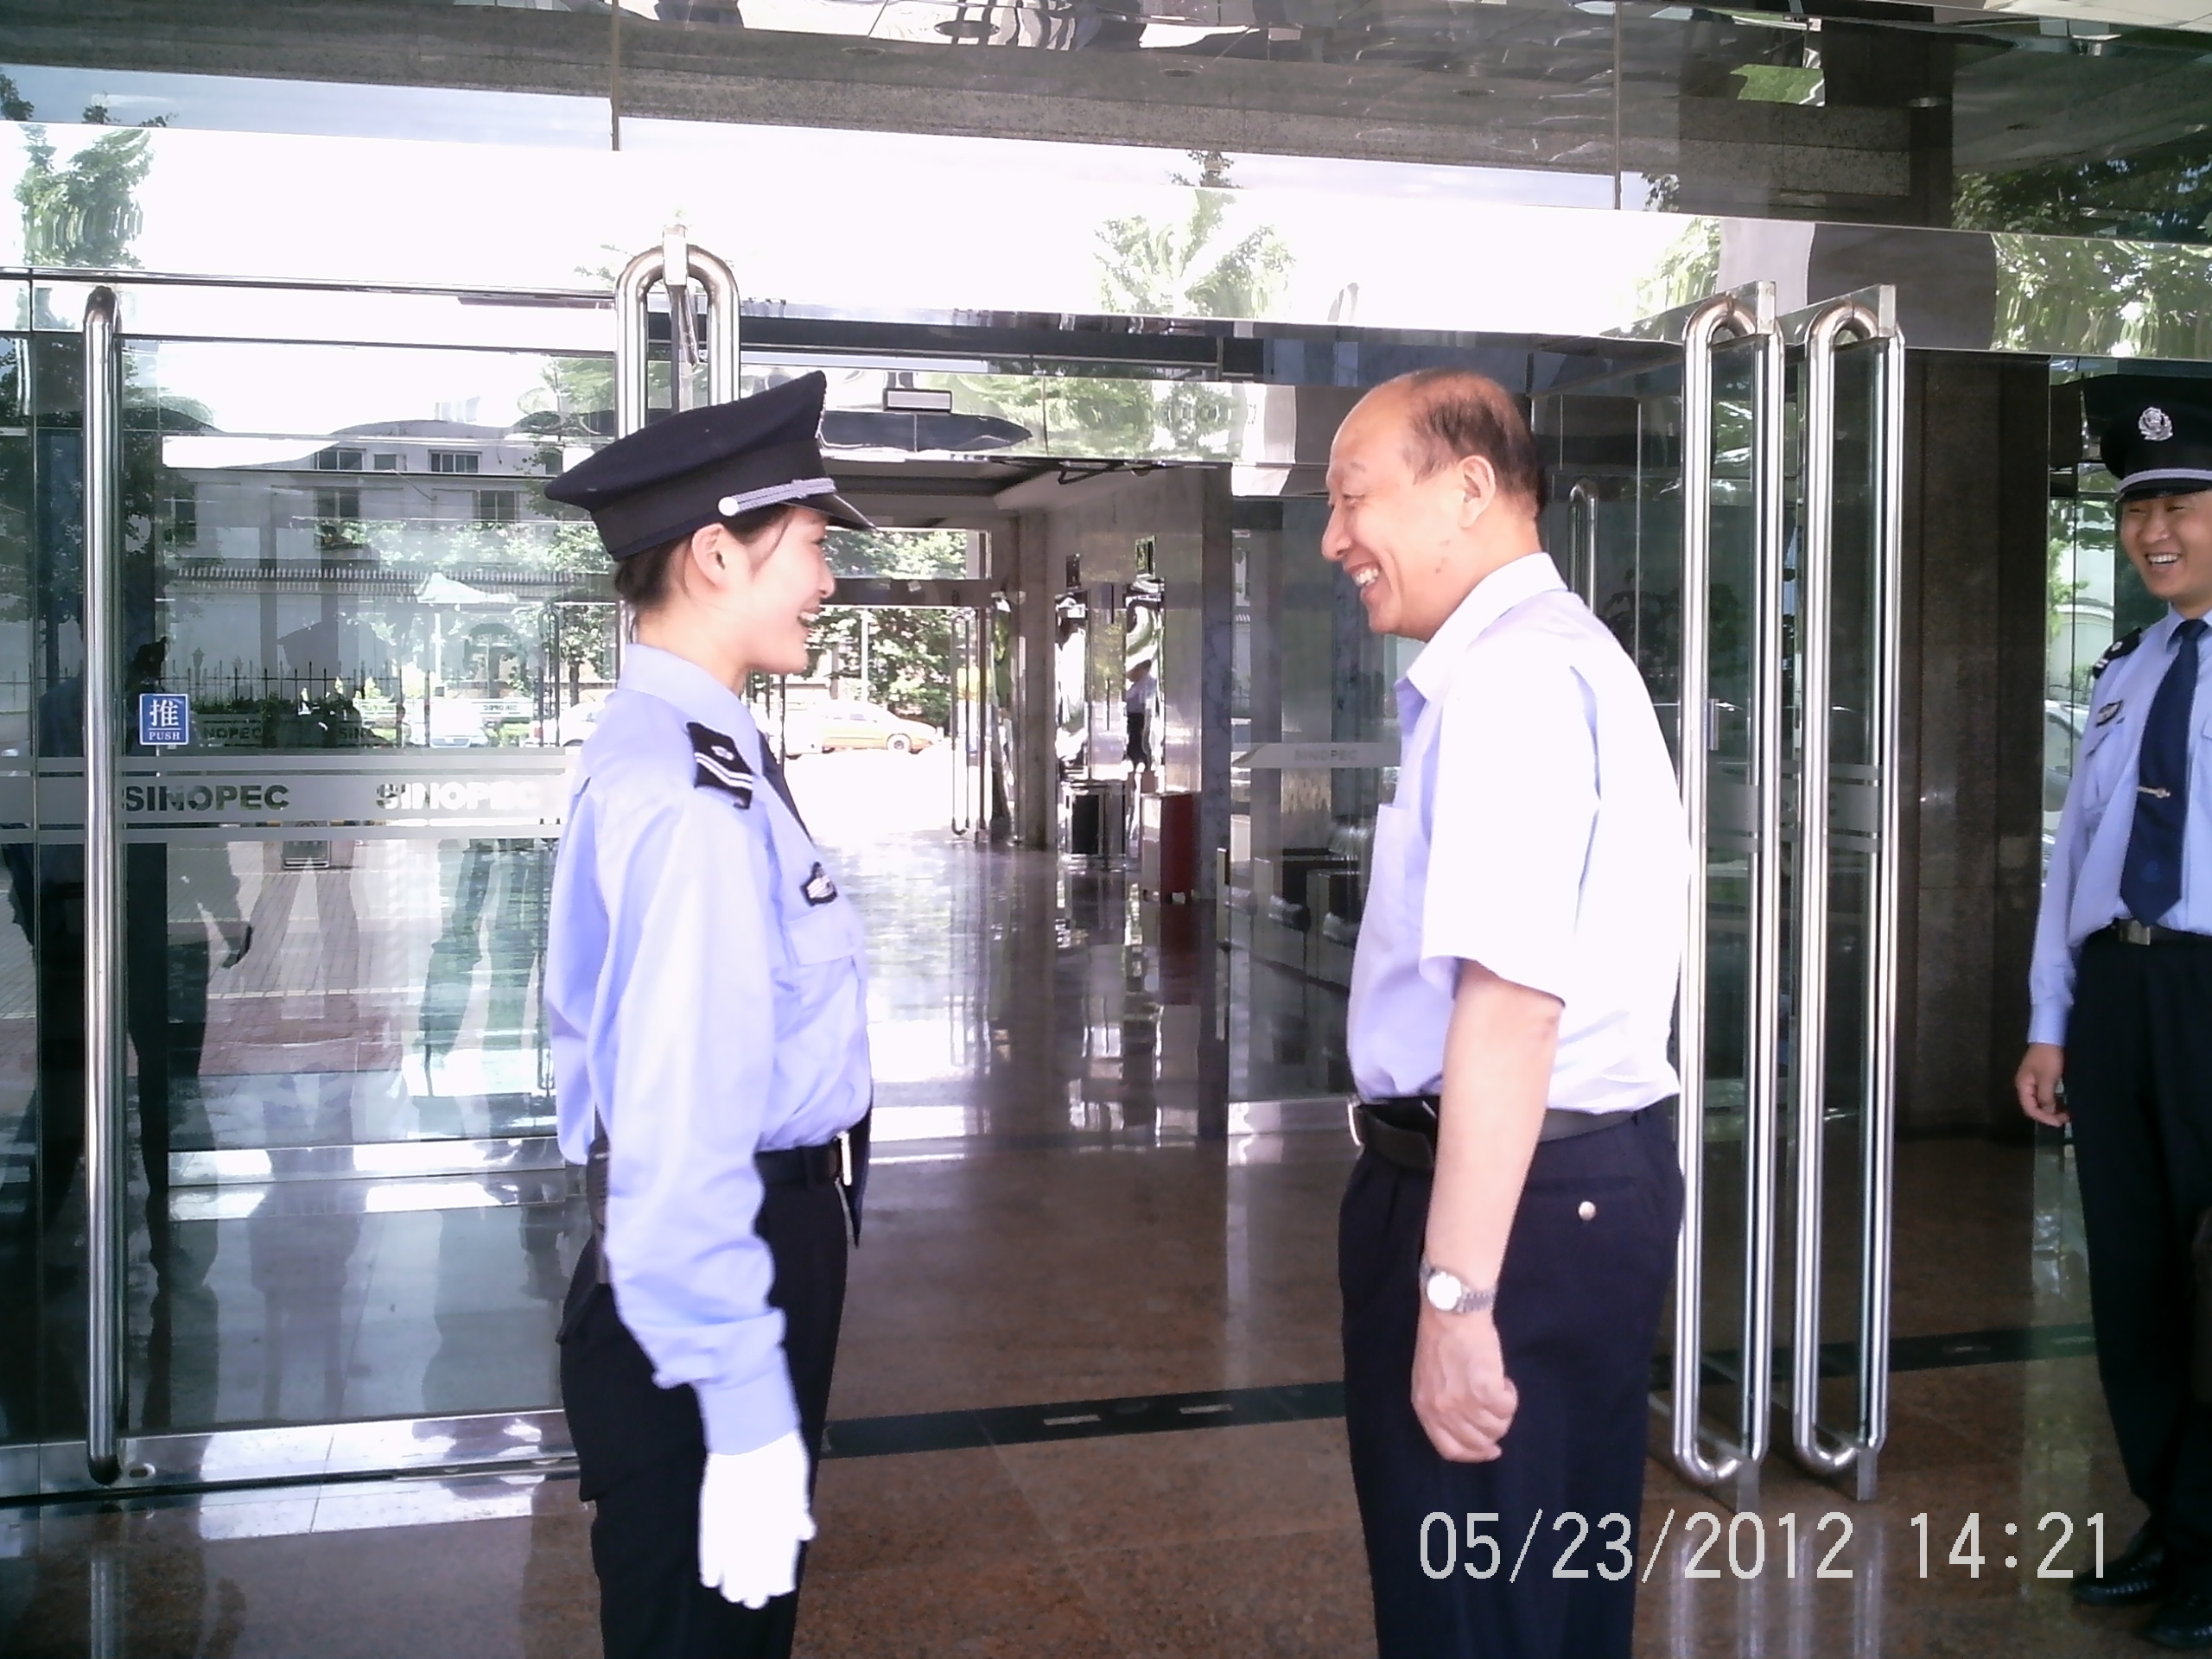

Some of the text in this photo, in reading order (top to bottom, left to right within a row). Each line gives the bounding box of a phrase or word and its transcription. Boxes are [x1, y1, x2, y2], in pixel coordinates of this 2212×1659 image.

[149, 698, 180, 728] 推
[149, 731, 181, 741] PUSH
[125, 785, 289, 811] SINOPEC
